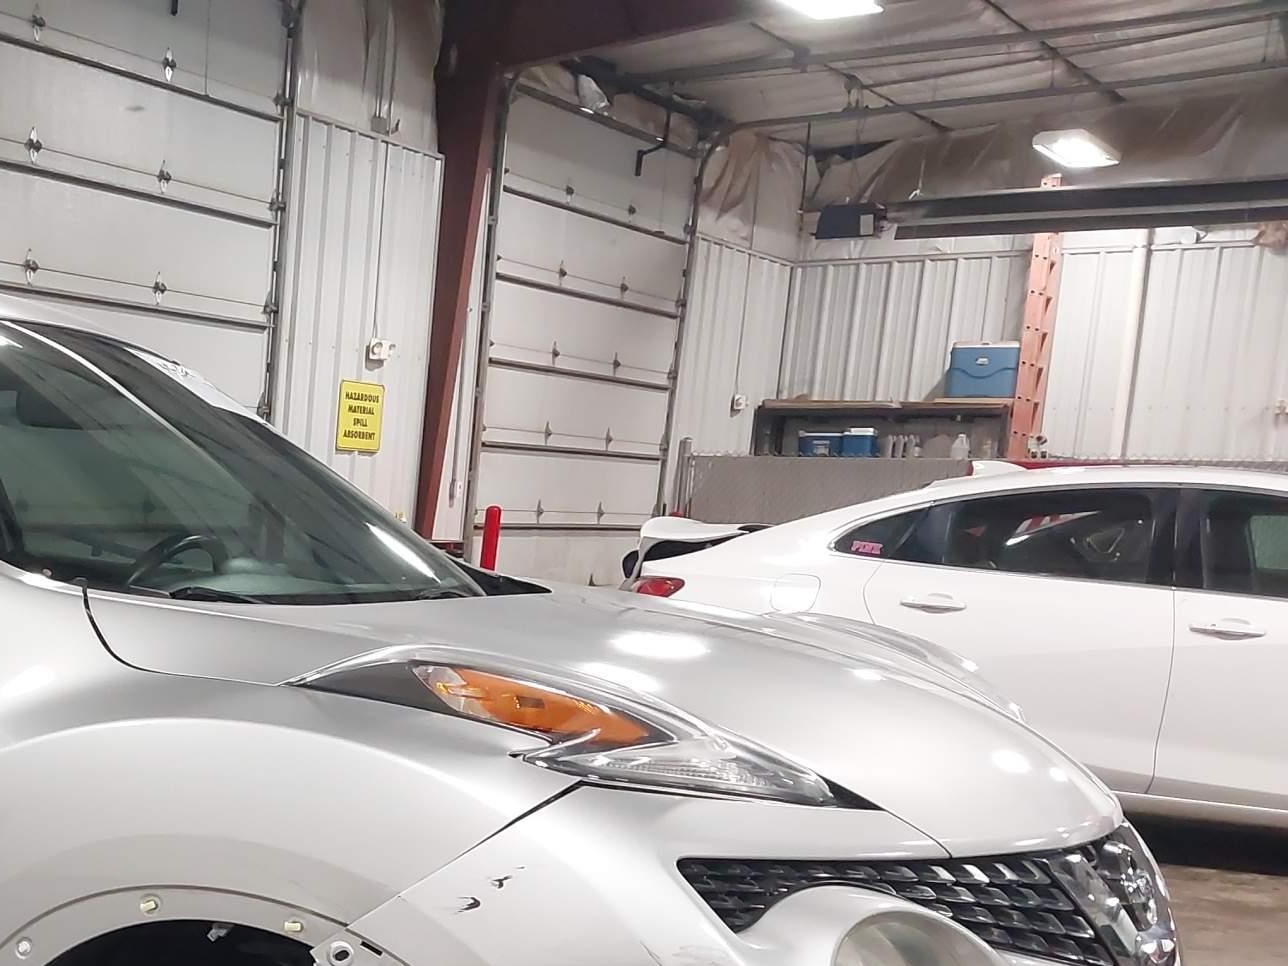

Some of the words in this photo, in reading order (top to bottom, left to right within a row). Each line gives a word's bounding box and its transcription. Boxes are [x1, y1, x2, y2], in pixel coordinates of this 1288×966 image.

[345, 391, 380, 403] HAZARDOUS
[348, 404, 375, 415] MATERIAL
[352, 417, 368, 428] SPILL
[343, 429, 376, 441] ABSORBENT
